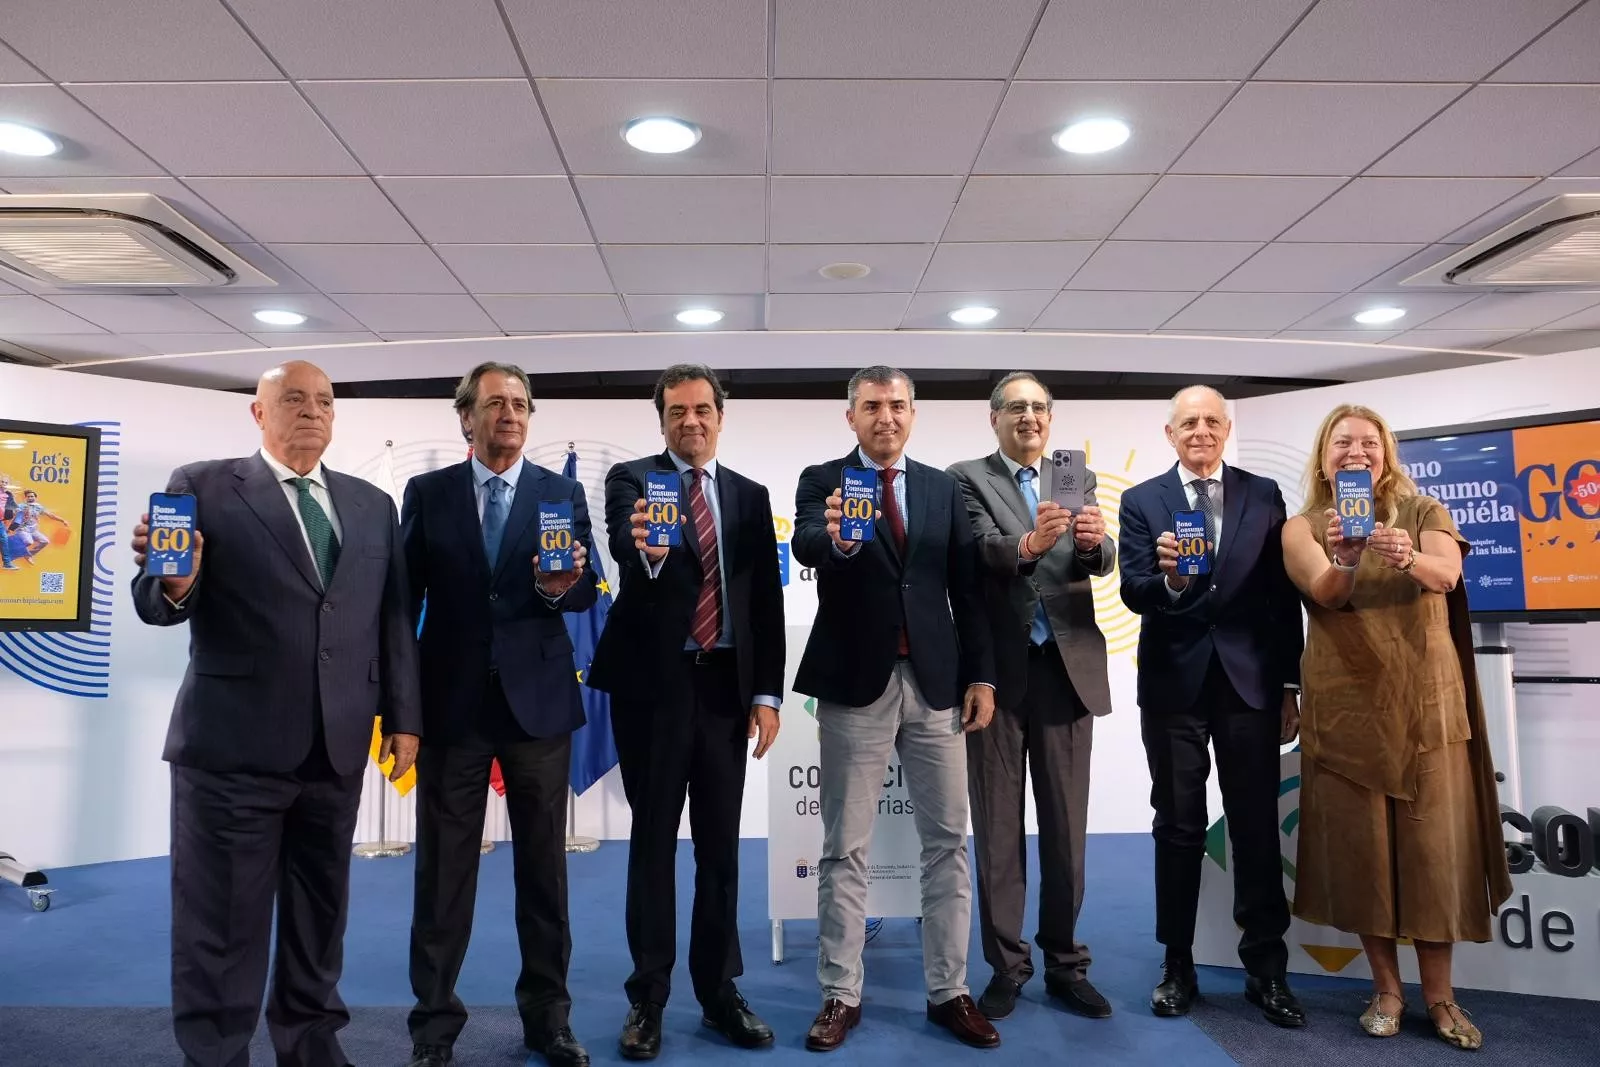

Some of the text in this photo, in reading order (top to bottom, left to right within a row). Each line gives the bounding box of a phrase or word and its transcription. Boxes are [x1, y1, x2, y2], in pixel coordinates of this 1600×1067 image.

[30, 466, 70, 484] GO!!
[1400, 460, 1442, 479] ono
[845, 477, 863, 485] Bono
[1416, 480, 1498, 501] nsumo
[152, 505, 177, 514] Bono
[152, 513, 192, 522] Consumo
[648, 502, 678, 525] GO
[843, 498, 873, 520] GO
[1340, 498, 1370, 518] GO
[150, 528, 190, 552] GO
[540, 529, 571, 551] GO
[1177, 537, 1205, 557] GO
[1475, 546, 1489, 555] las
[796, 794, 915, 816] de rias
[1500, 894, 1575, 953] de
